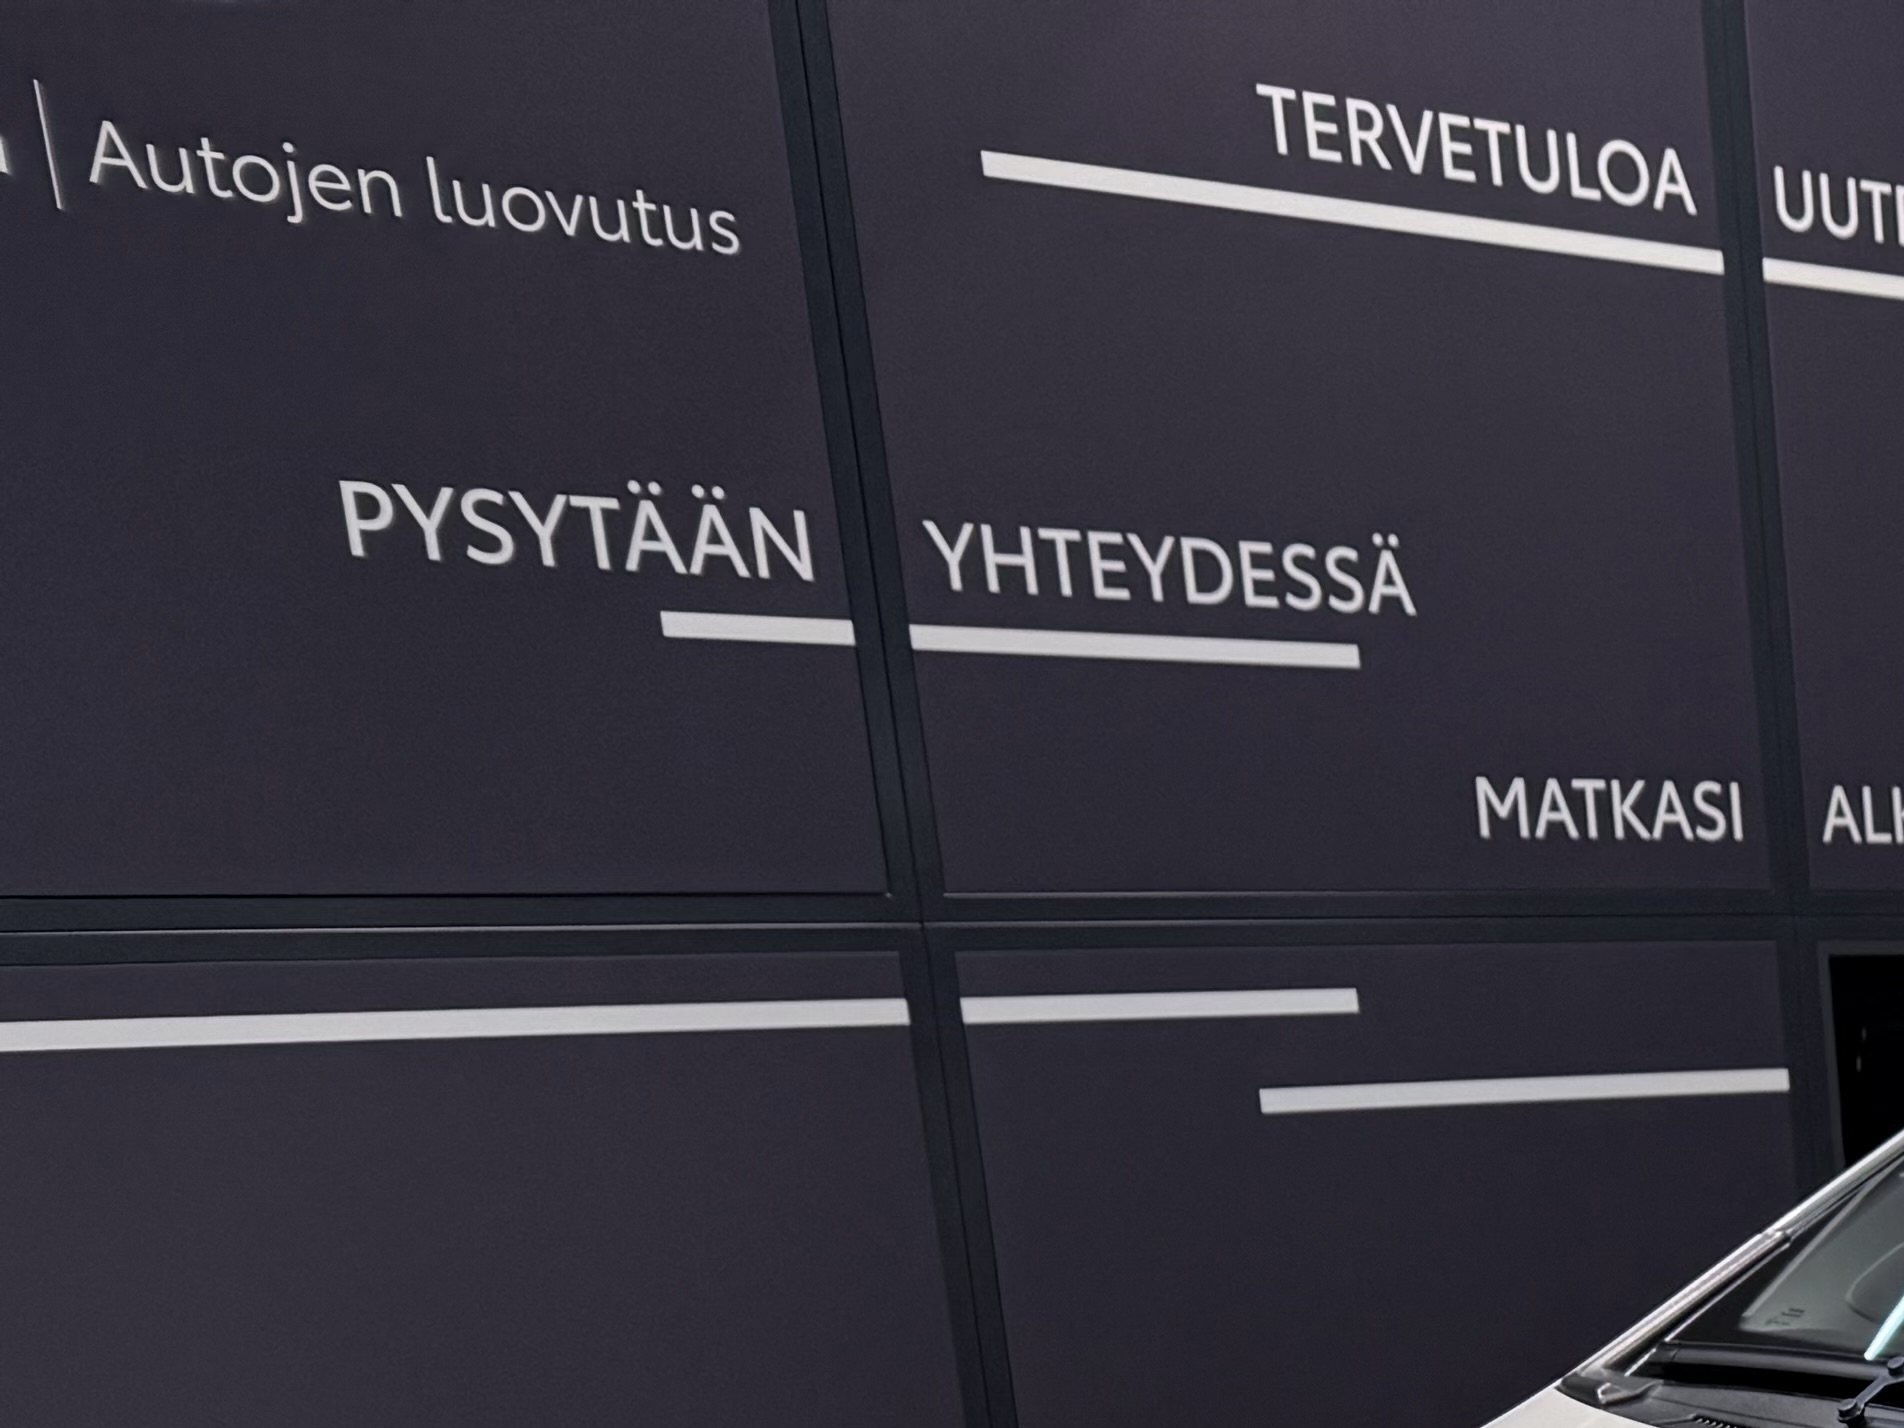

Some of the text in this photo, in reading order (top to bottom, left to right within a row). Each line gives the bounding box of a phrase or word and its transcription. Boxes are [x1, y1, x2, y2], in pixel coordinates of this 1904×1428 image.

[89, 121, 403, 224] Autojen
[426, 156, 741, 255] luovutus
[1256, 83, 1697, 215] TERVETULOA
[339, 480, 1416, 616] PYSYTÄÄN YHTEYDESSÄ
[1476, 777, 1744, 842] MATKASI
